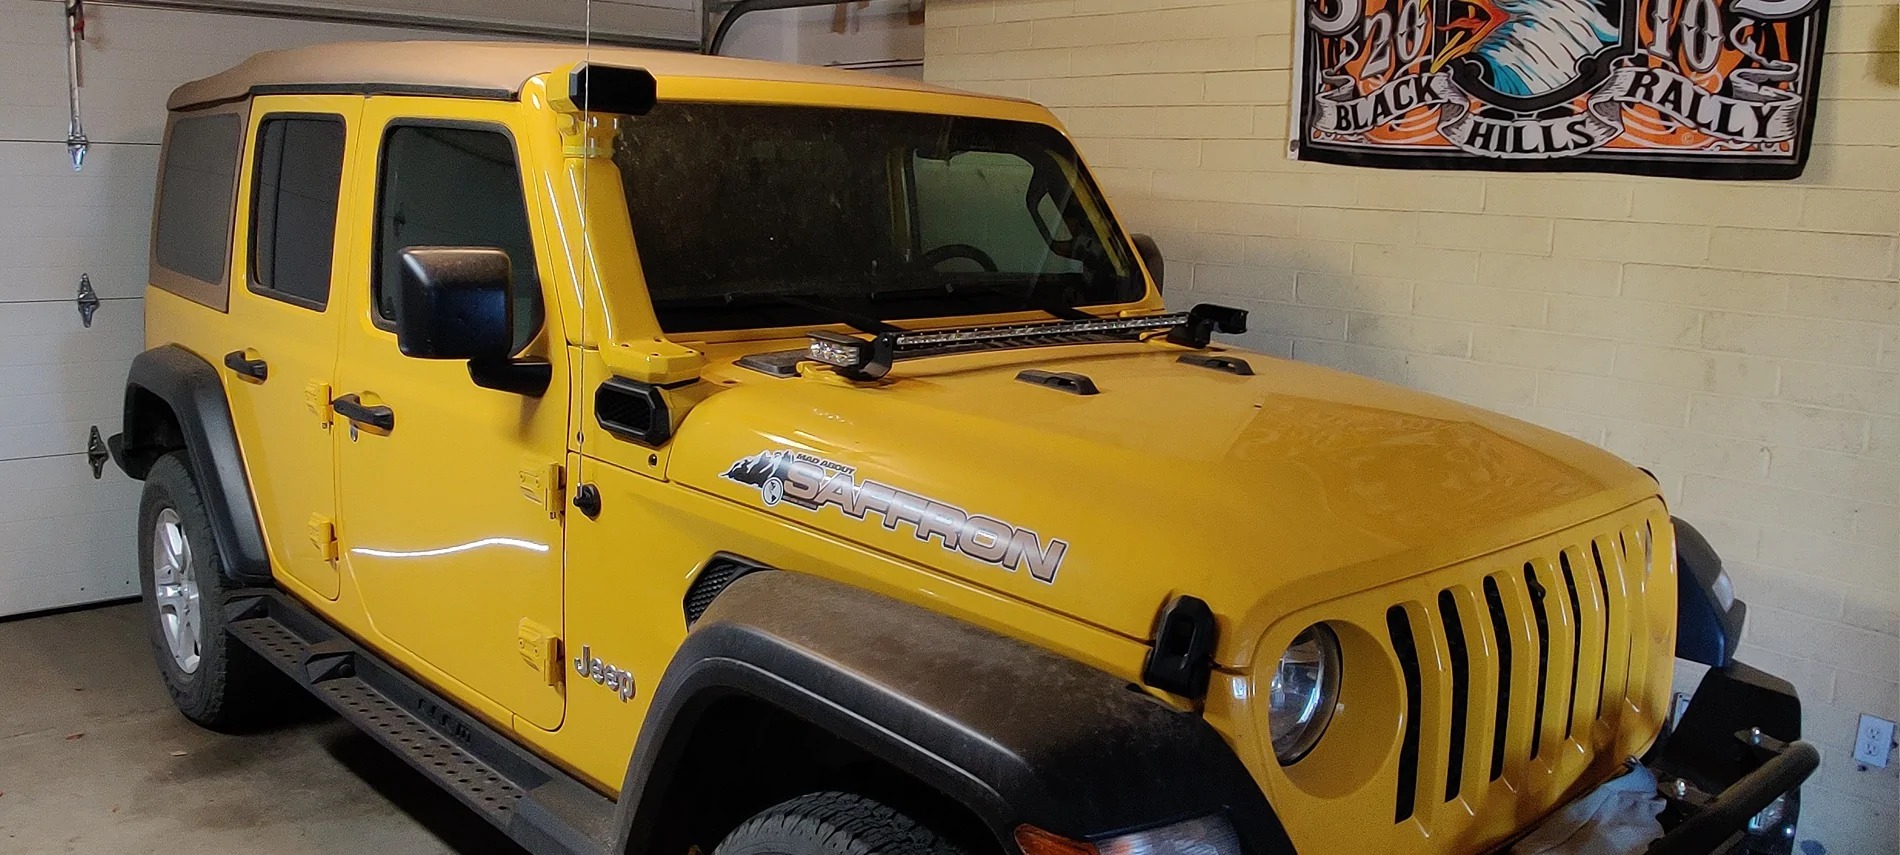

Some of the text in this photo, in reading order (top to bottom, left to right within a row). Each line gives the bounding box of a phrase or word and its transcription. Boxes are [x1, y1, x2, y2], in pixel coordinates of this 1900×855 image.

[1359, 0, 1430, 80] 20
[1647, 0, 1726, 73] 10
[1334, 70, 1781, 153] BLACK HILLS RALLY
[796, 453, 856, 475] MAD ABOUT
[782, 460, 1067, 583] SAFFRON
[573, 643, 637, 704] Jeep
